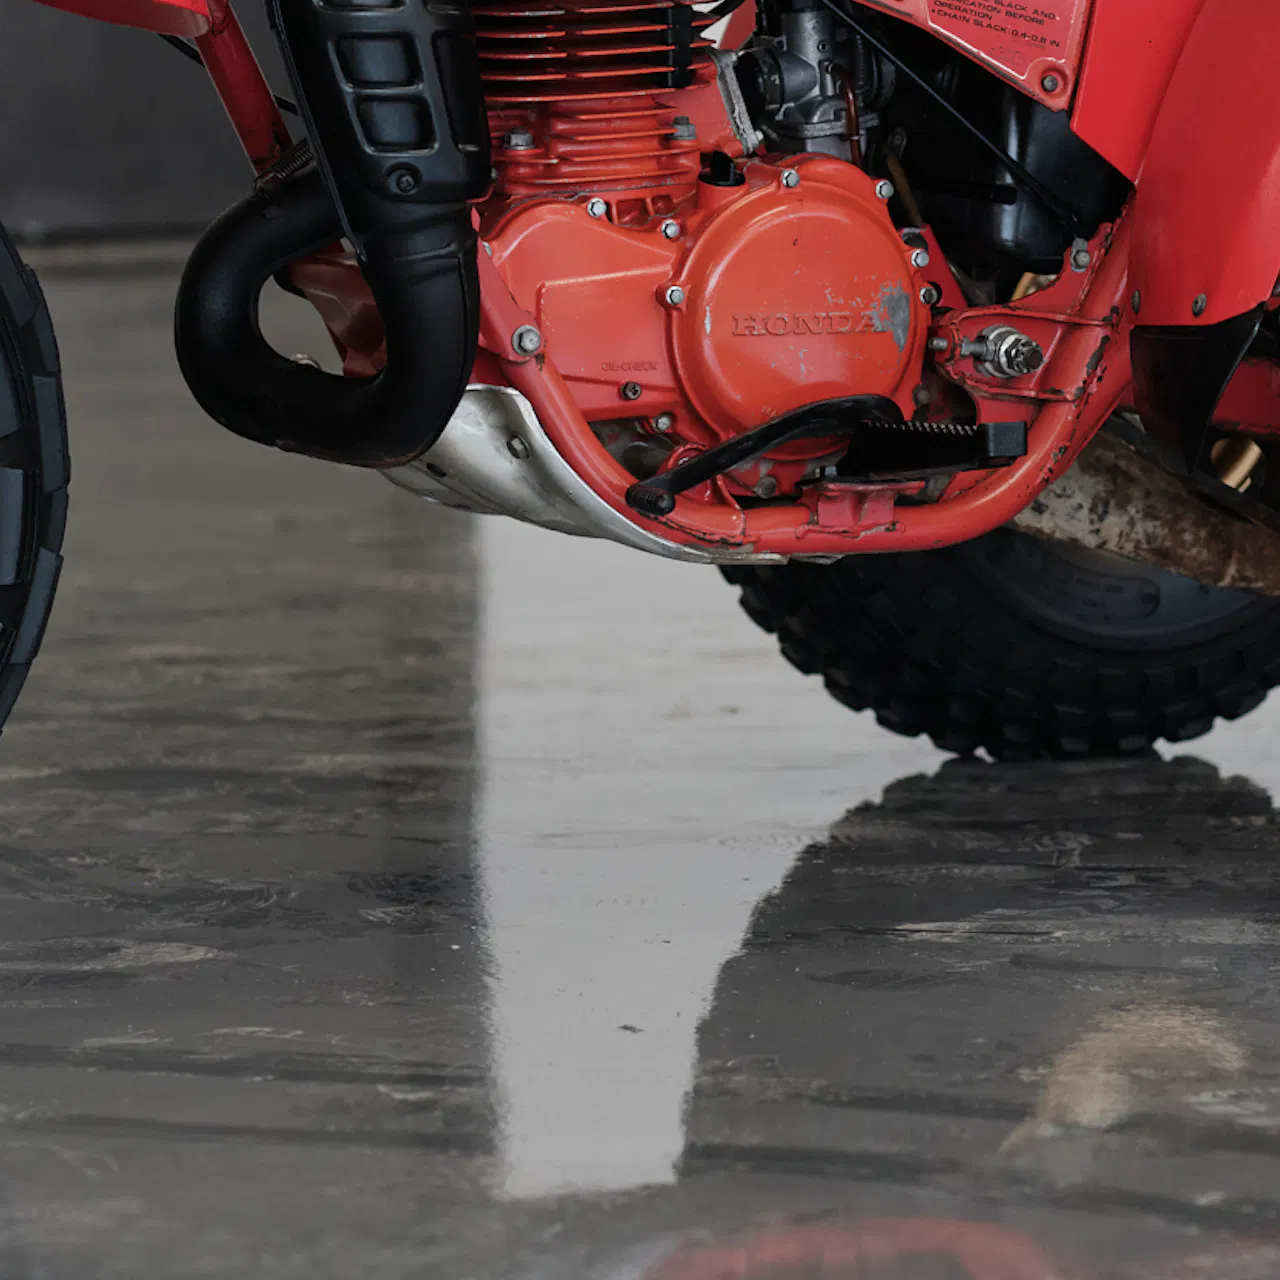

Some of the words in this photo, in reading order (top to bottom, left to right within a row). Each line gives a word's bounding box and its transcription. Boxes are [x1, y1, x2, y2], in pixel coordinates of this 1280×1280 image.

[934, 0, 993, 20] OPERATION
[1005, 10, 1045, 26] BEFORE
[1032, 9, 1056, 20] AND
[936, 10, 969, 23] CHAIN
[1050, 39, 1060, 48] IN
[732, 311, 887, 336] HONDA
